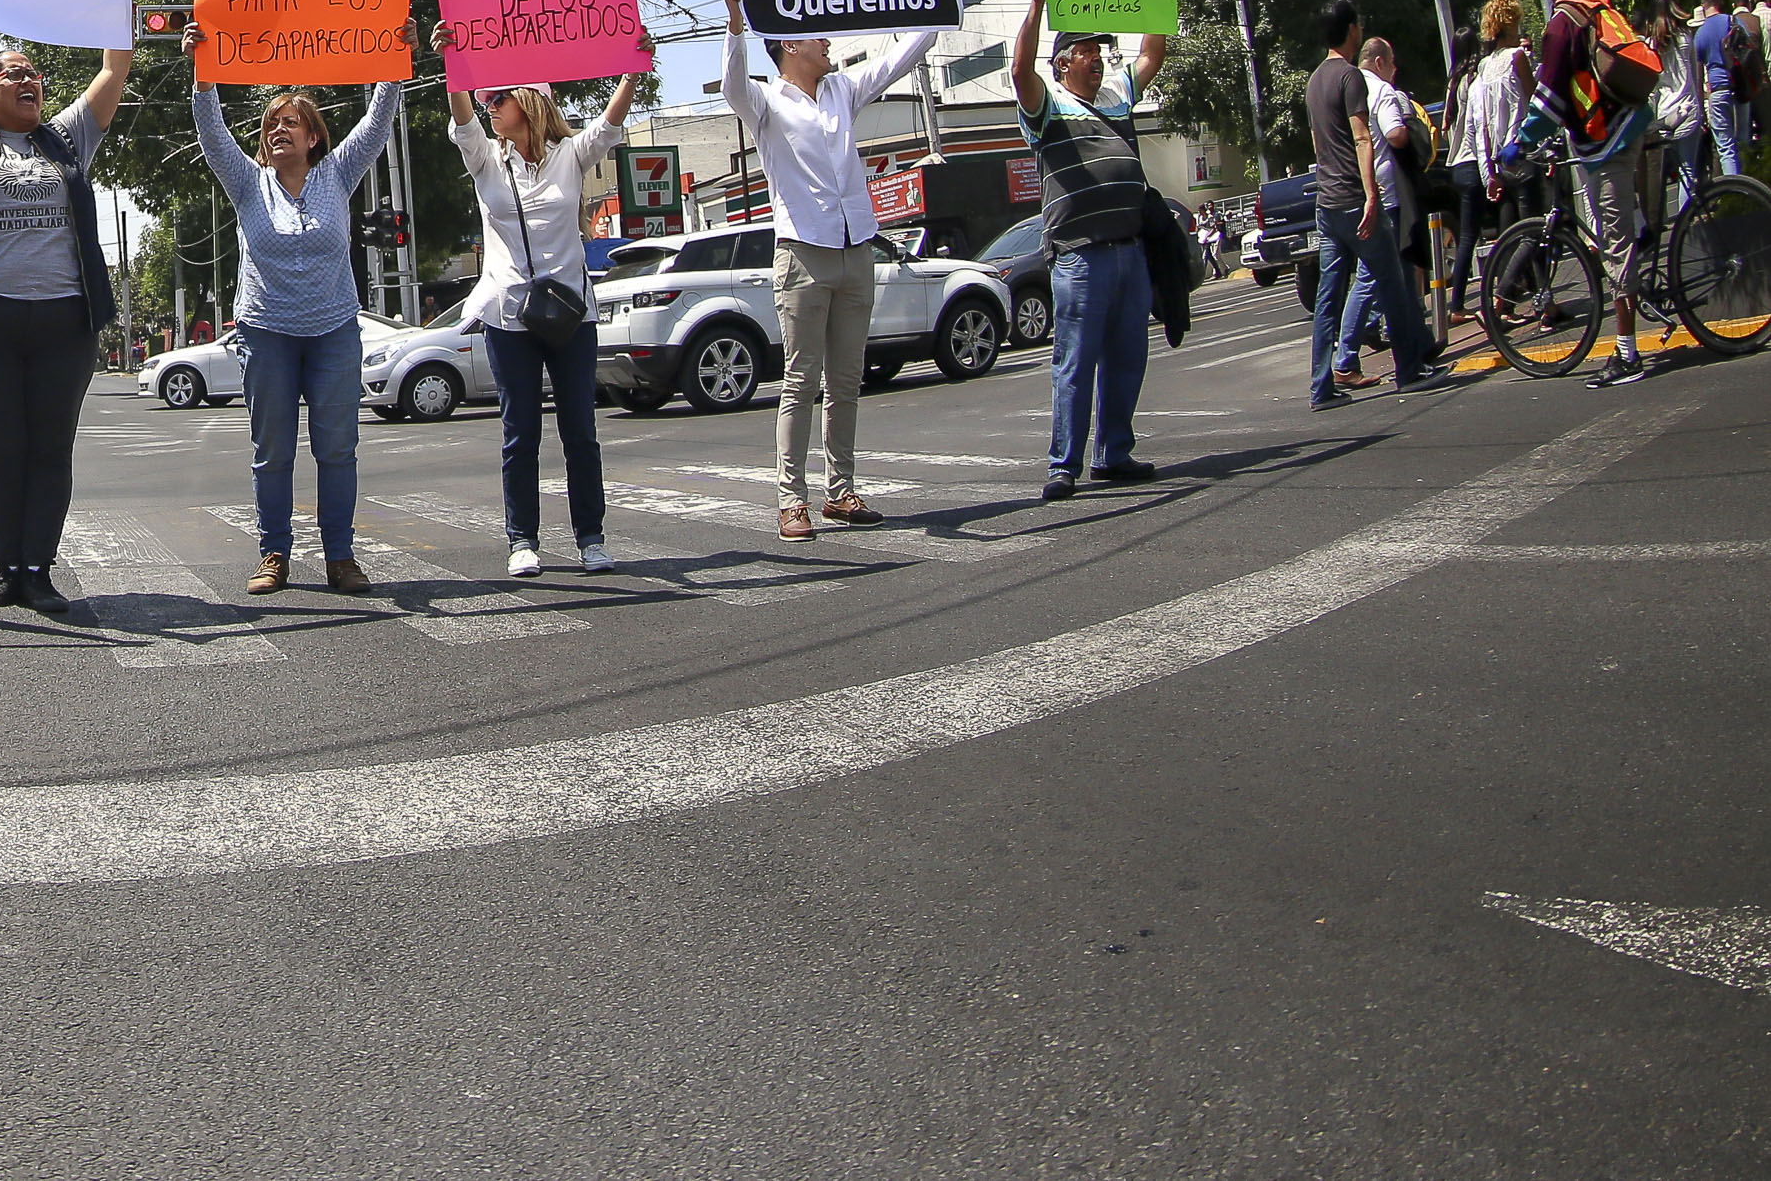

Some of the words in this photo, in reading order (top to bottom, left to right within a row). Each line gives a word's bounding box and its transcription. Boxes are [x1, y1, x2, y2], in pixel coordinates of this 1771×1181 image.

[215, 25, 407, 66] DESAPARECIDOS
[454, 2, 636, 52] DESAPARECIDOS
[646, 221, 665, 237] 24
